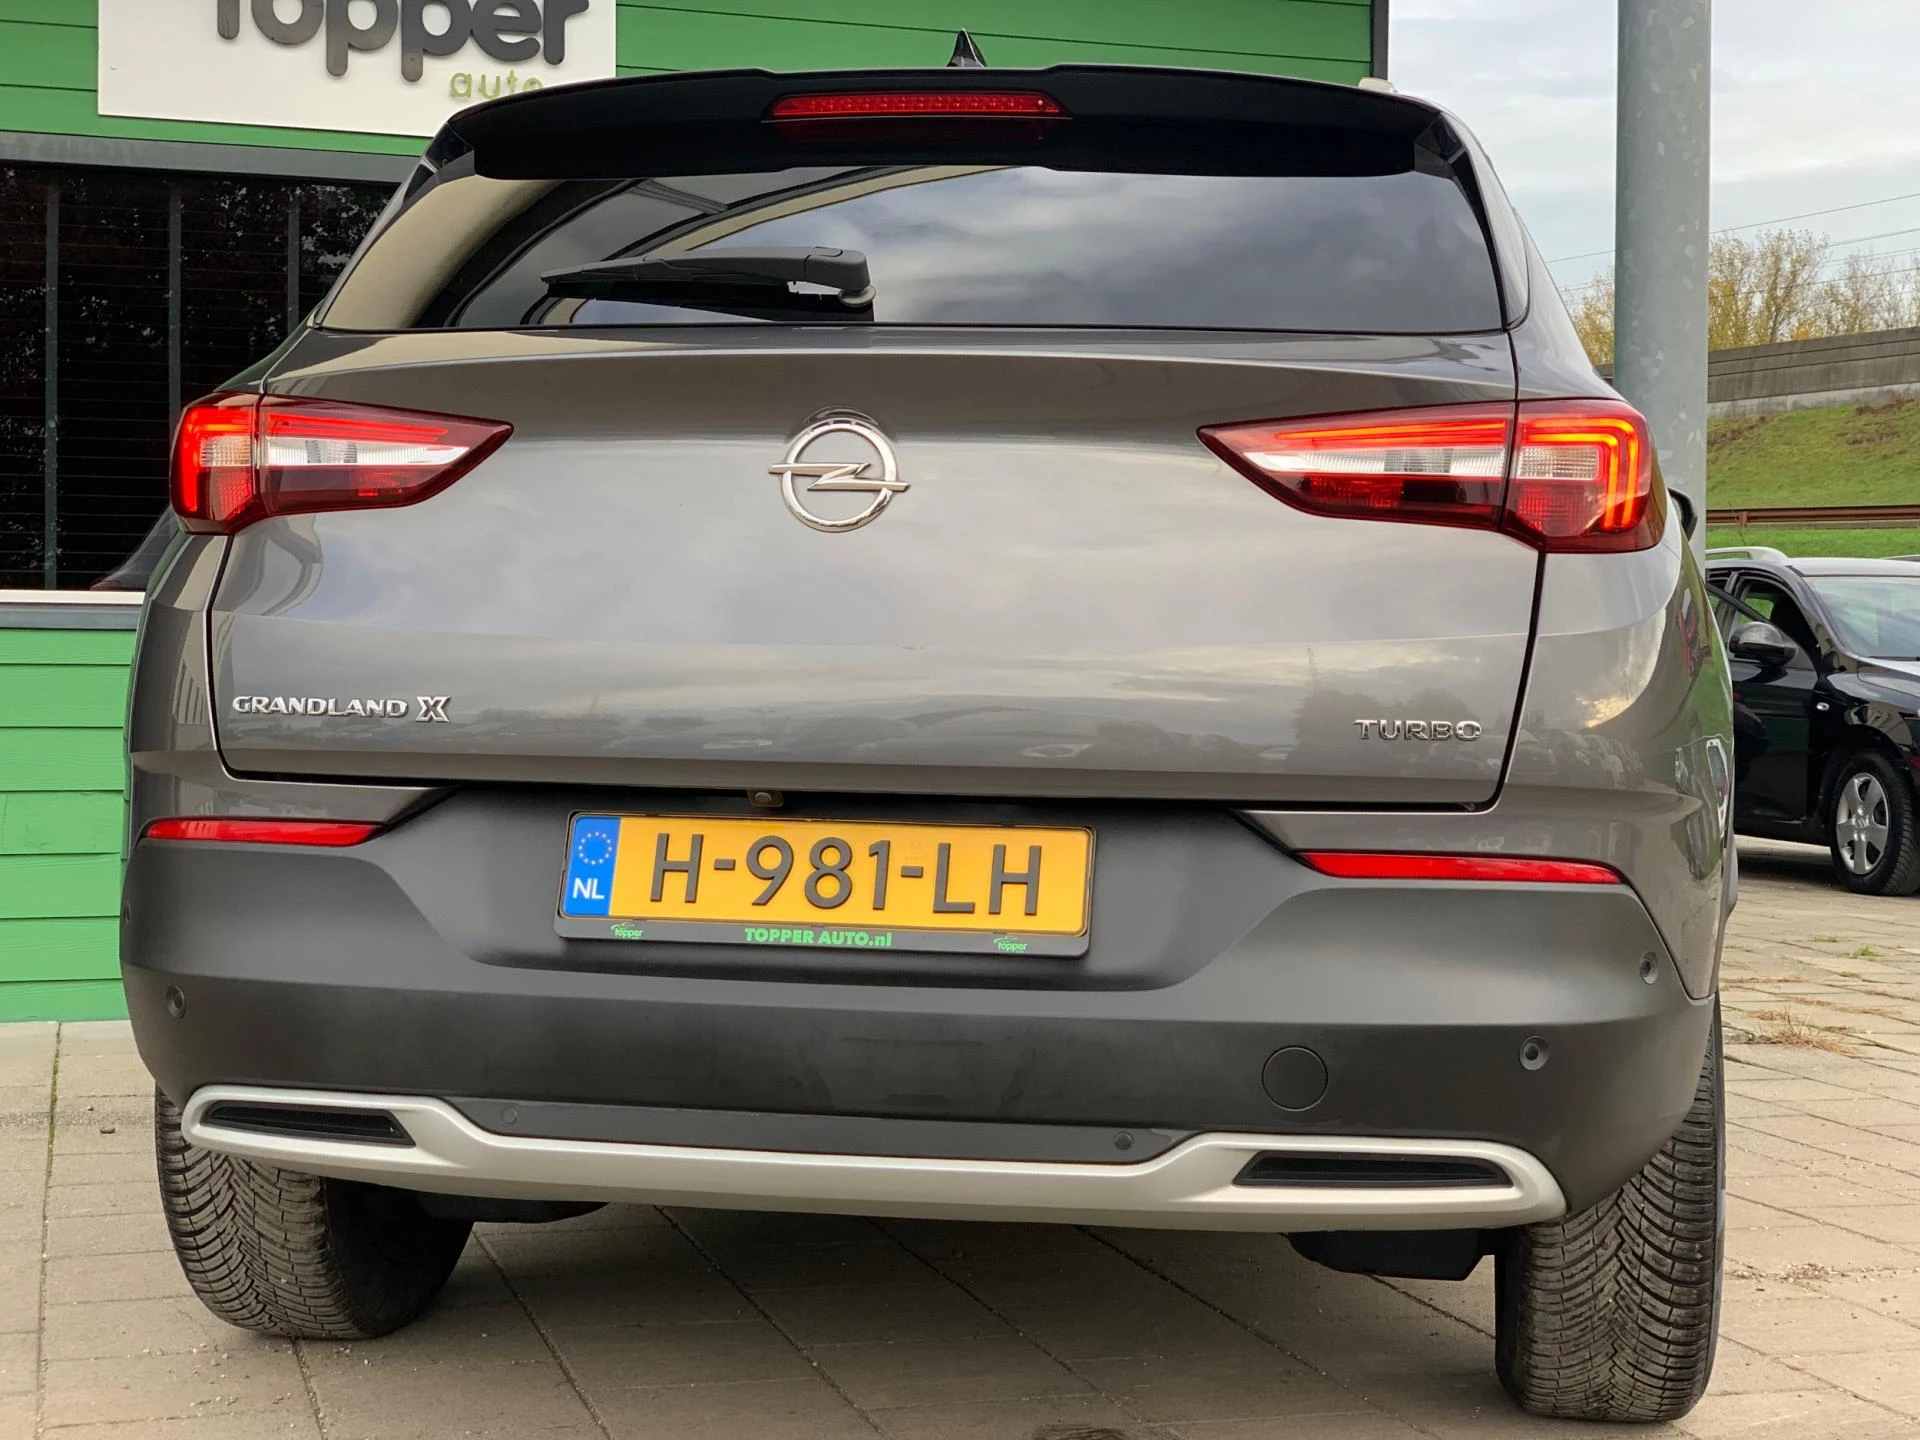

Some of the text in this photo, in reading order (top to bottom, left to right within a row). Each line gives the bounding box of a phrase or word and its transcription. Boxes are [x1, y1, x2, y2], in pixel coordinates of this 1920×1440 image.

[232, 695, 451, 723] GRANDLAND X
[1354, 719, 1482, 741] TURBO
[650, 832, 1042, 916] H-981-LH
[572, 877, 605, 899] NL
[744, 927, 893, 947] TOPPER AUTO.nl
